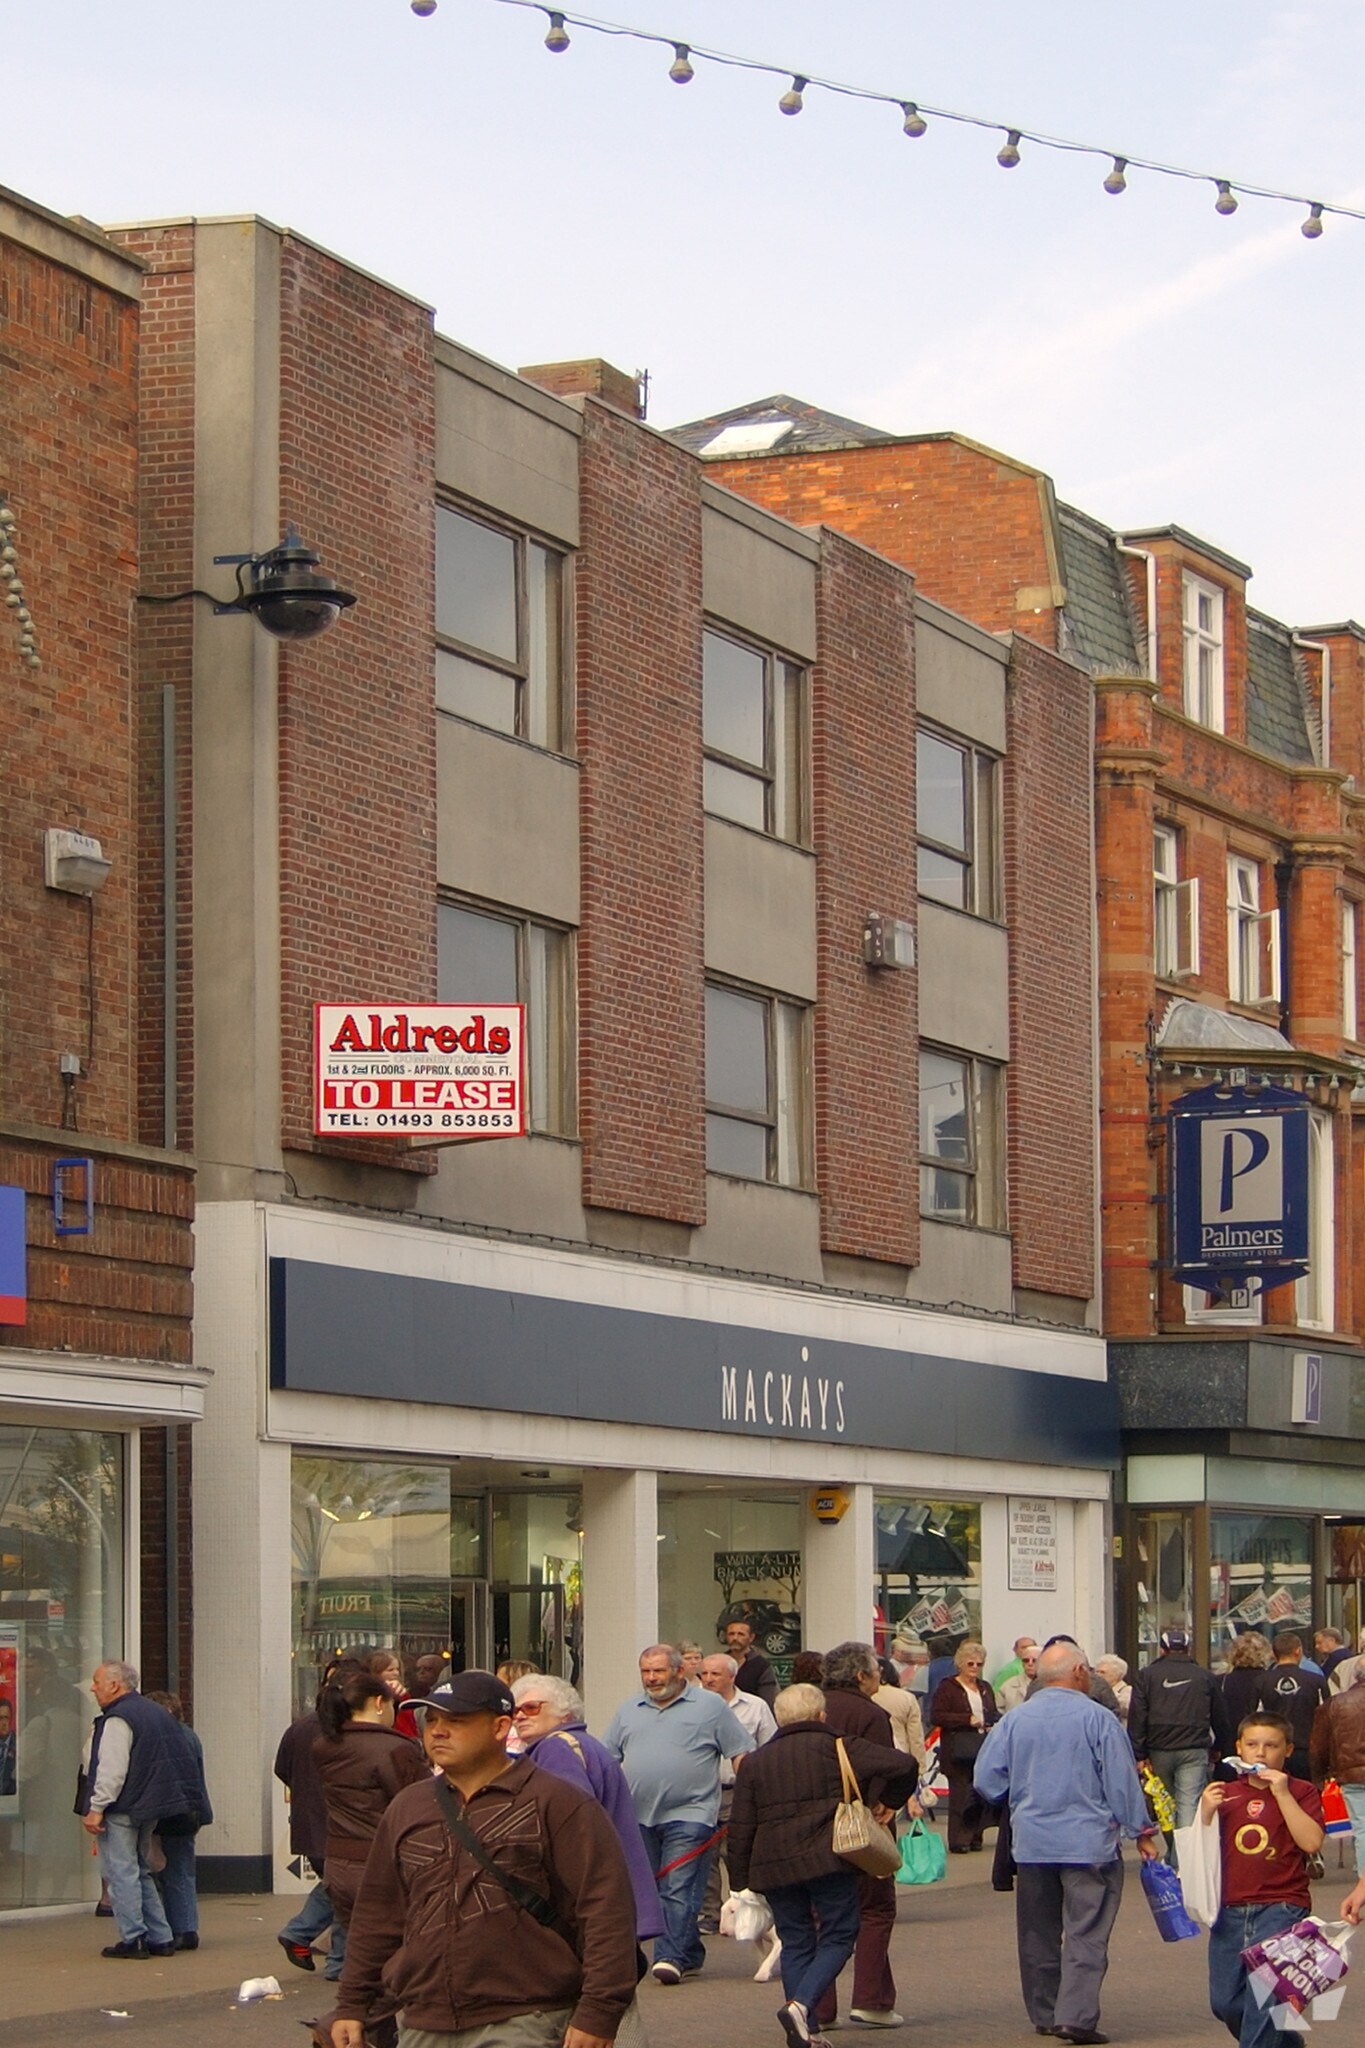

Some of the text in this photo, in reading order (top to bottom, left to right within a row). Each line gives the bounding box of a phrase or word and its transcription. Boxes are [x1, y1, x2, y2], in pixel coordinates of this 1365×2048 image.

[329, 1014, 511, 1054] Aldreds
[327, 1065, 339, 1075] 1st
[342, 1065, 349, 1075] &
[352, 1065, 368, 1075] 2nd
[371, 1065, 405, 1075] FLOORS
[414, 1065, 452, 1076] APPROX.
[482, 1066, 497, 1076] SQ.
[499, 1066, 512, 1076] FT.
[328, 1081, 512, 1109] TO LEASE
[328, 1114, 513, 1127] TEL: 01493 853853
[1219, 1127, 1270, 1213] P
[1201, 1225, 1284, 1247] Palmers
[1201, 1249, 1283, 1259] DEPARTMENT STORE
[721, 1365, 845, 1432] MACKAYS
[725, 1553, 801, 1566] WIN A LIT
[717, 1566, 766, 1578] BLACK
[1235, 1823, 1276, 1860] O2
